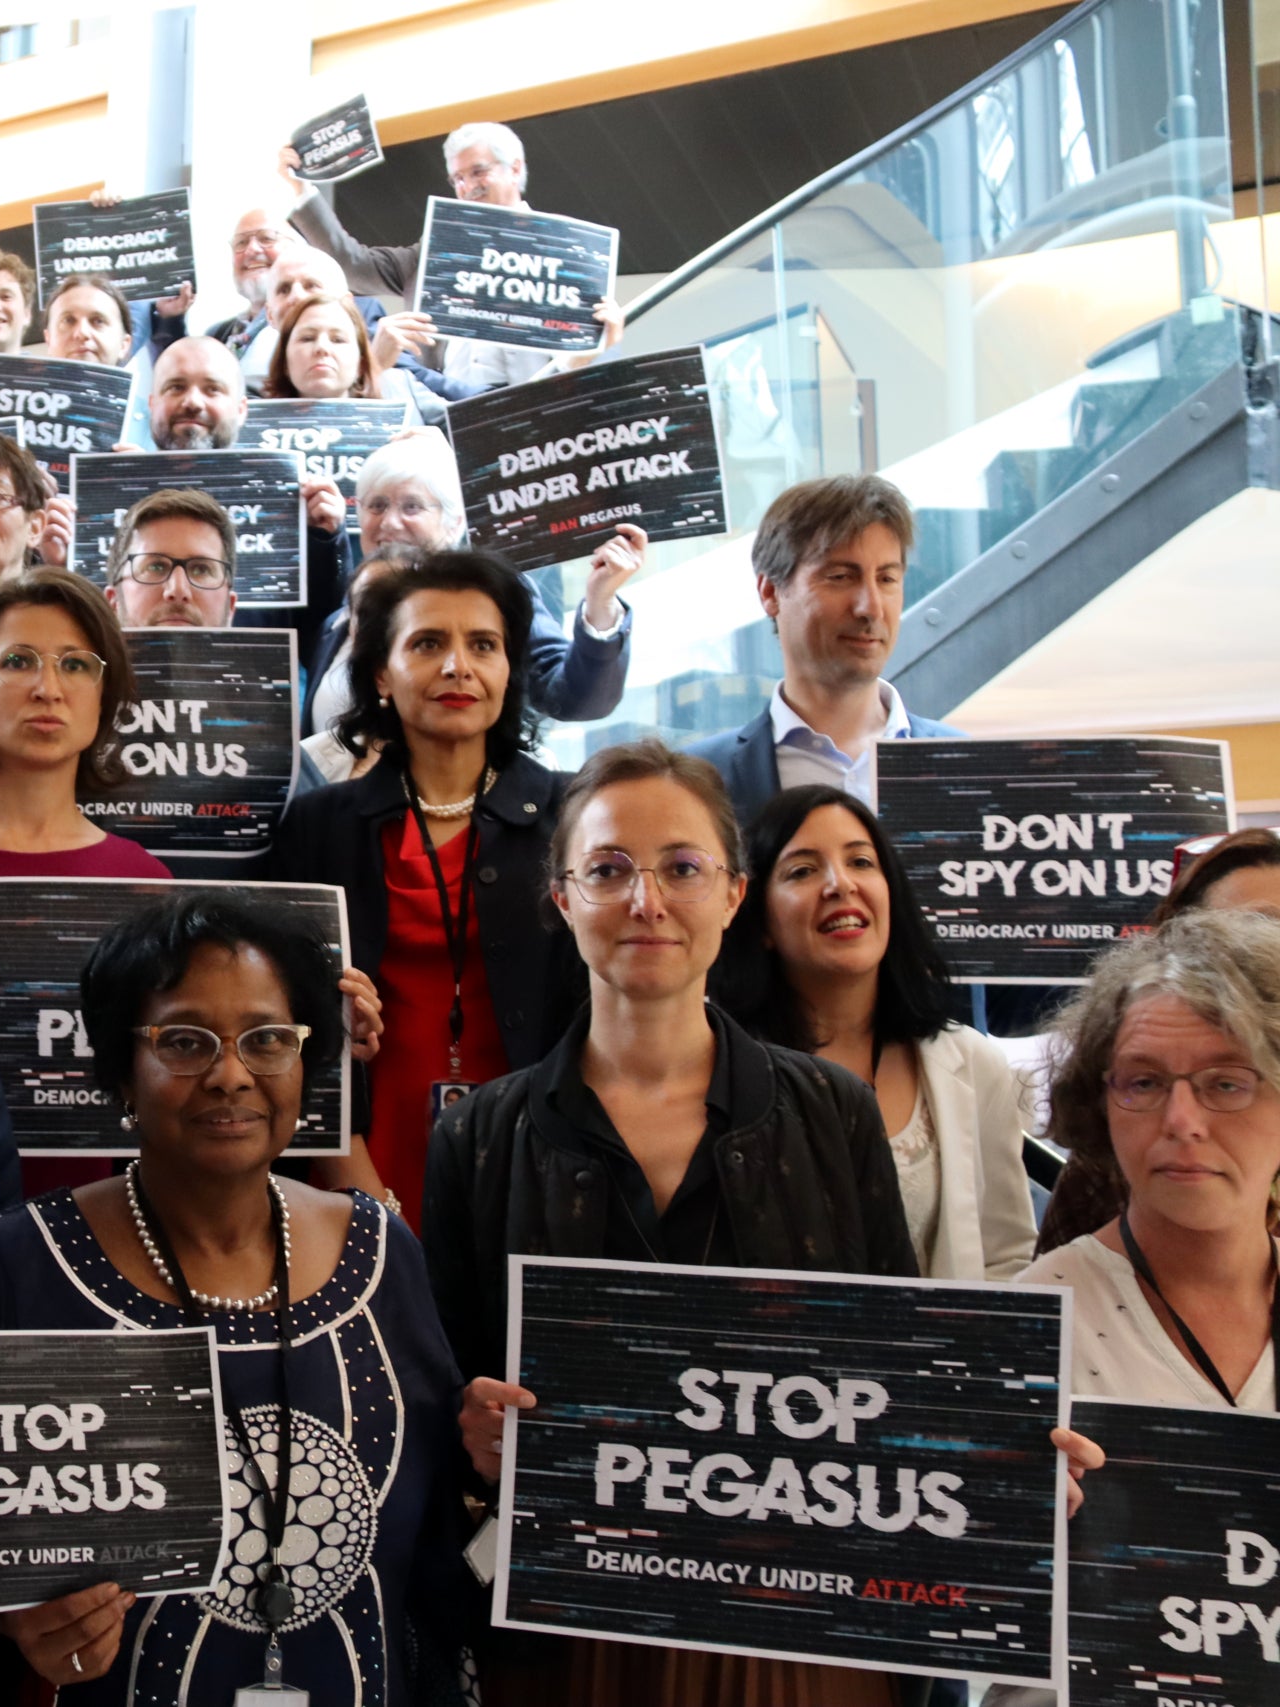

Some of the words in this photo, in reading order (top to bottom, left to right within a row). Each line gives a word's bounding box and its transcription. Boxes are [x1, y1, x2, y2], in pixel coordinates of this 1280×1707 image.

[303, 129, 363, 166] PEGASUS
[311, 120, 346, 145] STOP
[62, 227, 168, 253] DEMOCRACY
[53, 255, 113, 273] UNDER
[115, 246, 179, 269] ATTACK
[481, 247, 563, 280] DON'T
[454, 270, 503, 297] SPY
[502, 279, 548, 304] ON
[547, 285, 581, 309] US
[448, 305, 508, 323] DEMOCRACY
[509, 313, 543, 328] UNDER
[543, 318, 580, 332] ATTACK
[258, 428, 343, 451] STOP
[497, 416, 671, 479] DEMOCRACY
[487, 473, 579, 517] UNDER
[585, 449, 692, 494] ATTACK
[549, 518, 578, 535] BAN
[578, 503, 643, 528] PEGASUS
[114, 700, 208, 735] ON'T
[121, 742, 187, 776] ON
[195, 742, 249, 777] US
[141, 802, 193, 817] UNDER
[197, 803, 251, 817] ATTACK
[981, 813, 1133, 851] DON'T
[938, 859, 1026, 898] SPY
[1029, 860, 1108, 898] ON
[1115, 859, 1174, 897] US
[936, 923, 1048, 940] DEMOCRACY
[1051, 924, 1115, 940] UNDER
[33, 1089, 101, 1105] DEMOC
[674, 1367, 889, 1444] STOP
[593, 1441, 969, 1540] PEGASUS
[28, 1547, 95, 1566] UNDER
[98, 1542, 172, 1563] ATTACK
[586, 1549, 750, 1586] DEMOCRACY
[760, 1567, 854, 1599] UNDER
[861, 1576, 968, 1608] ATTACK
[1158, 1595, 1280, 1663] SPY
